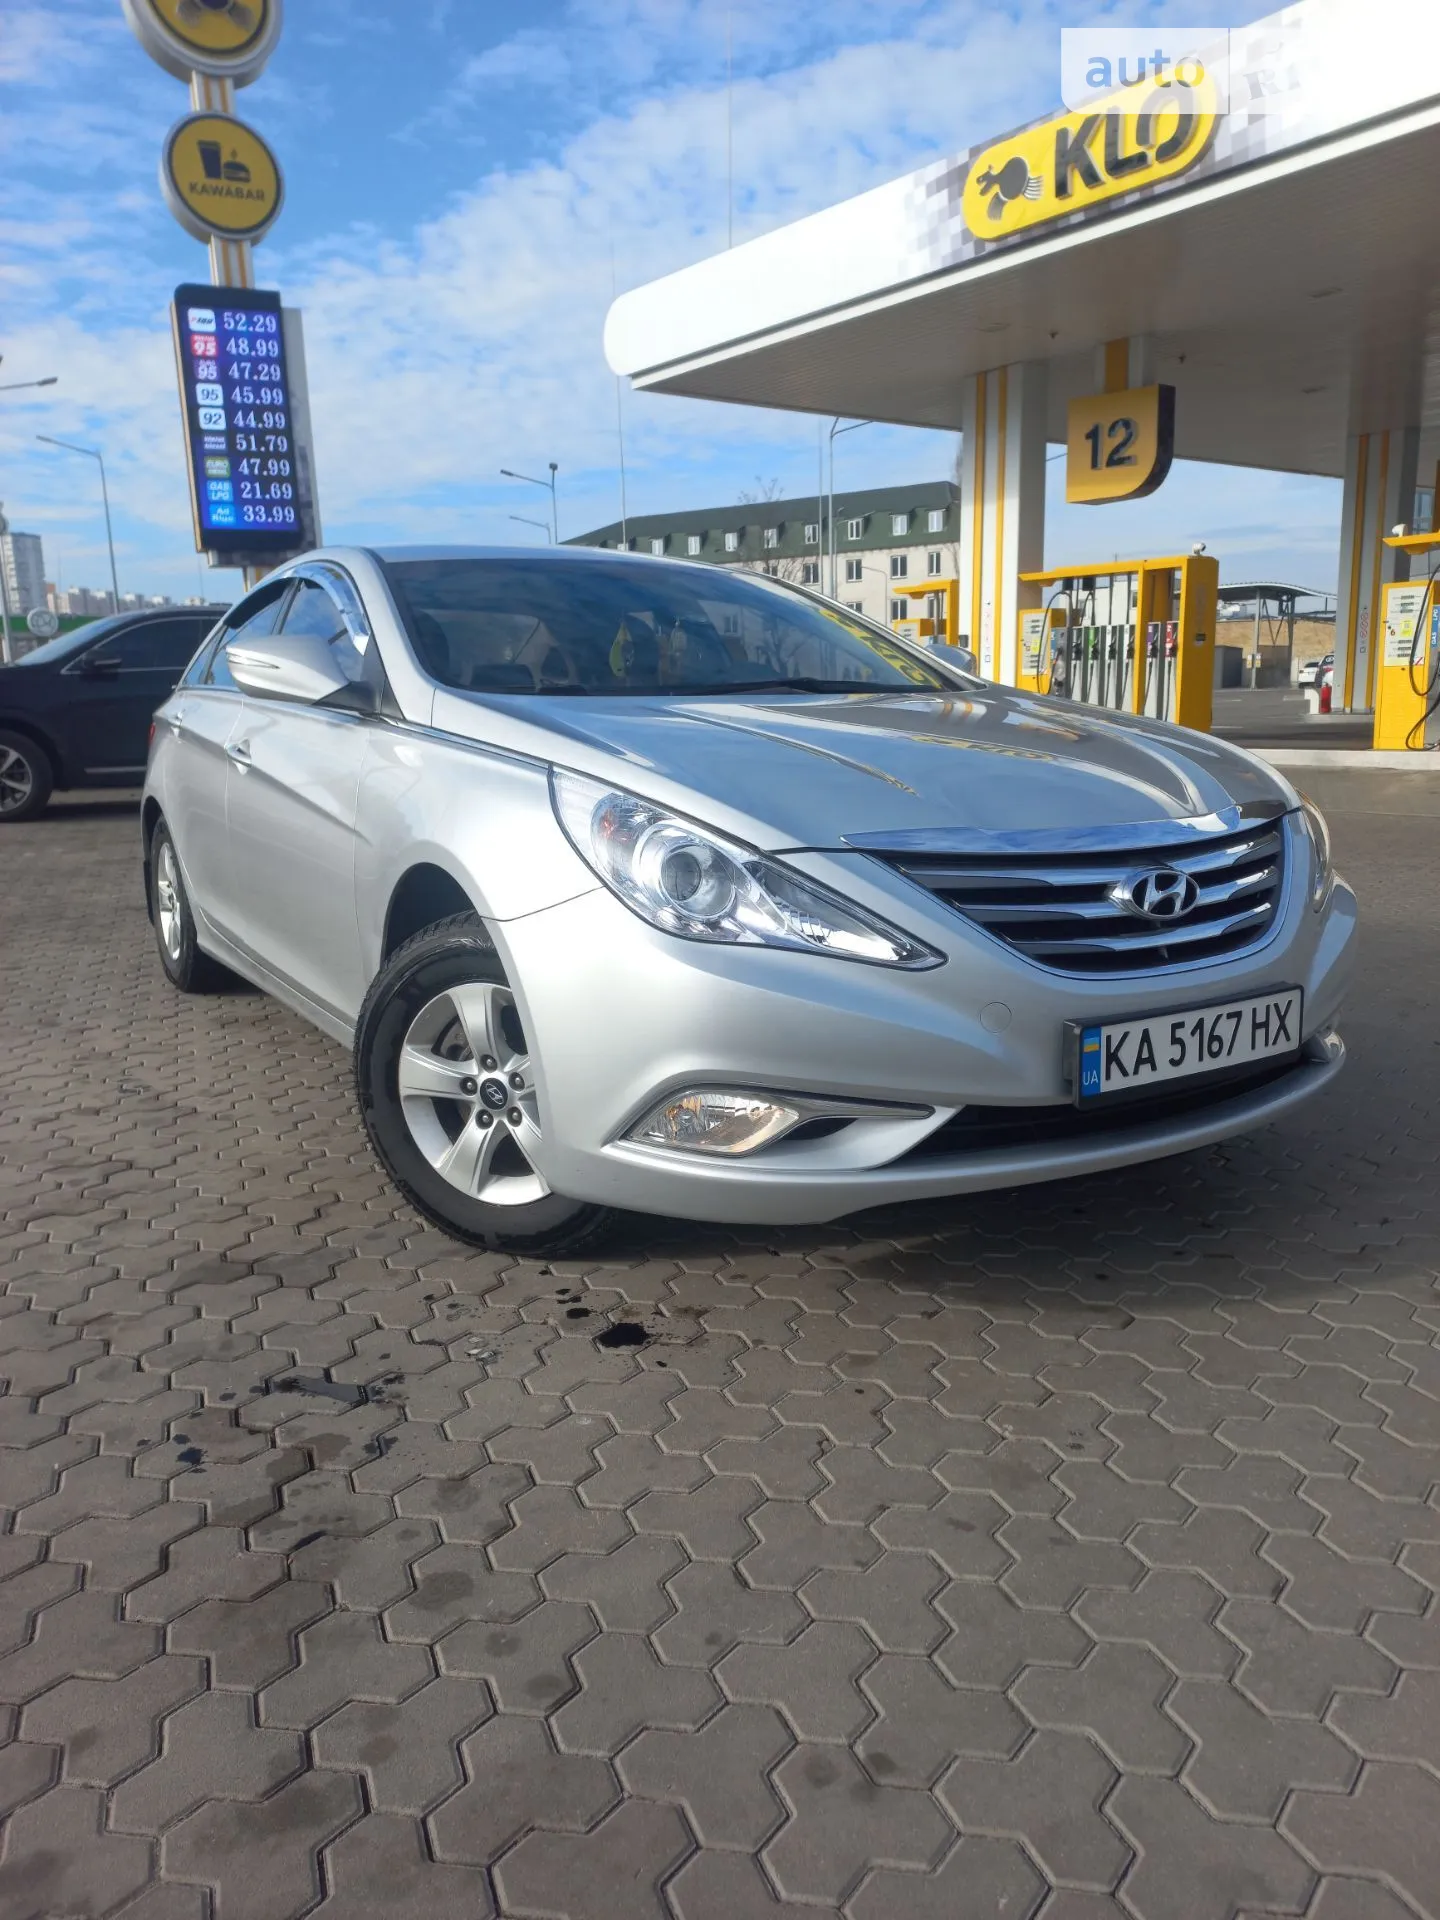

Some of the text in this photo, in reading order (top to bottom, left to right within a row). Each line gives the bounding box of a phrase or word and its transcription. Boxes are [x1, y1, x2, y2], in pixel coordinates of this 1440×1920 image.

[1055, 80, 1201, 199] KLO
[189, 183, 264, 202] KAWABAR
[223, 311, 277, 333] 52.29
[226, 337, 279, 358] 48.99
[228, 361, 281, 382] 47.29
[201, 386, 284, 406] 95 45.99
[203, 410, 286, 430] 92 44.99
[235, 433, 289, 453] 51.79
[1085, 417, 1137, 471] 12
[238, 457, 291, 477] 47.99
[211, 491, 229, 500] LPG
[240, 481, 293, 500] 21.69
[243, 504, 295, 524] 33.99
[1105, 999, 1292, 1081] KA 5167 HX
[1083, 1070, 1098, 1085] UA
